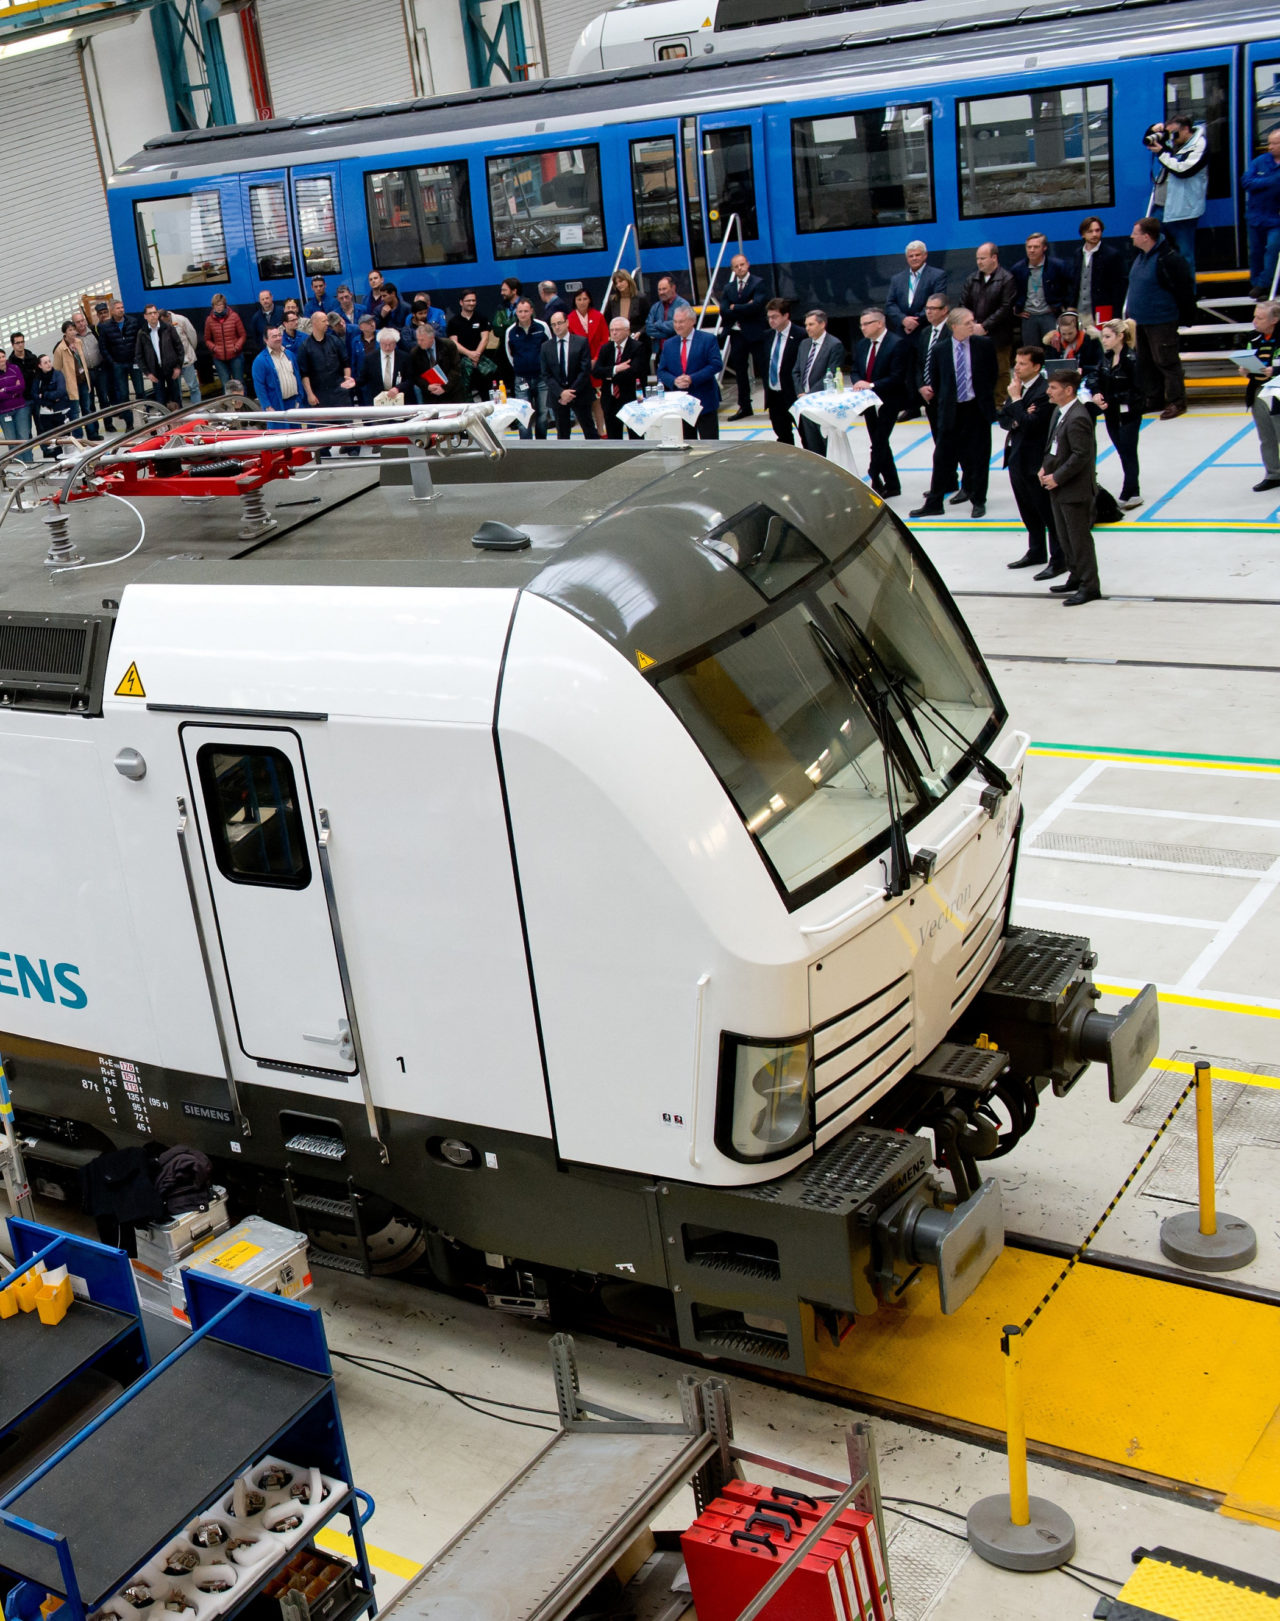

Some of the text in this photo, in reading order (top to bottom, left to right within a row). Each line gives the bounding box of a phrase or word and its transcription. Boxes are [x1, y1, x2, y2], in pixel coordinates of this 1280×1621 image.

[919, 883, 972, 946] Vectron
[396, 1055, 407, 1074] 1
[184, 1105, 231, 1122] SIEMENS
